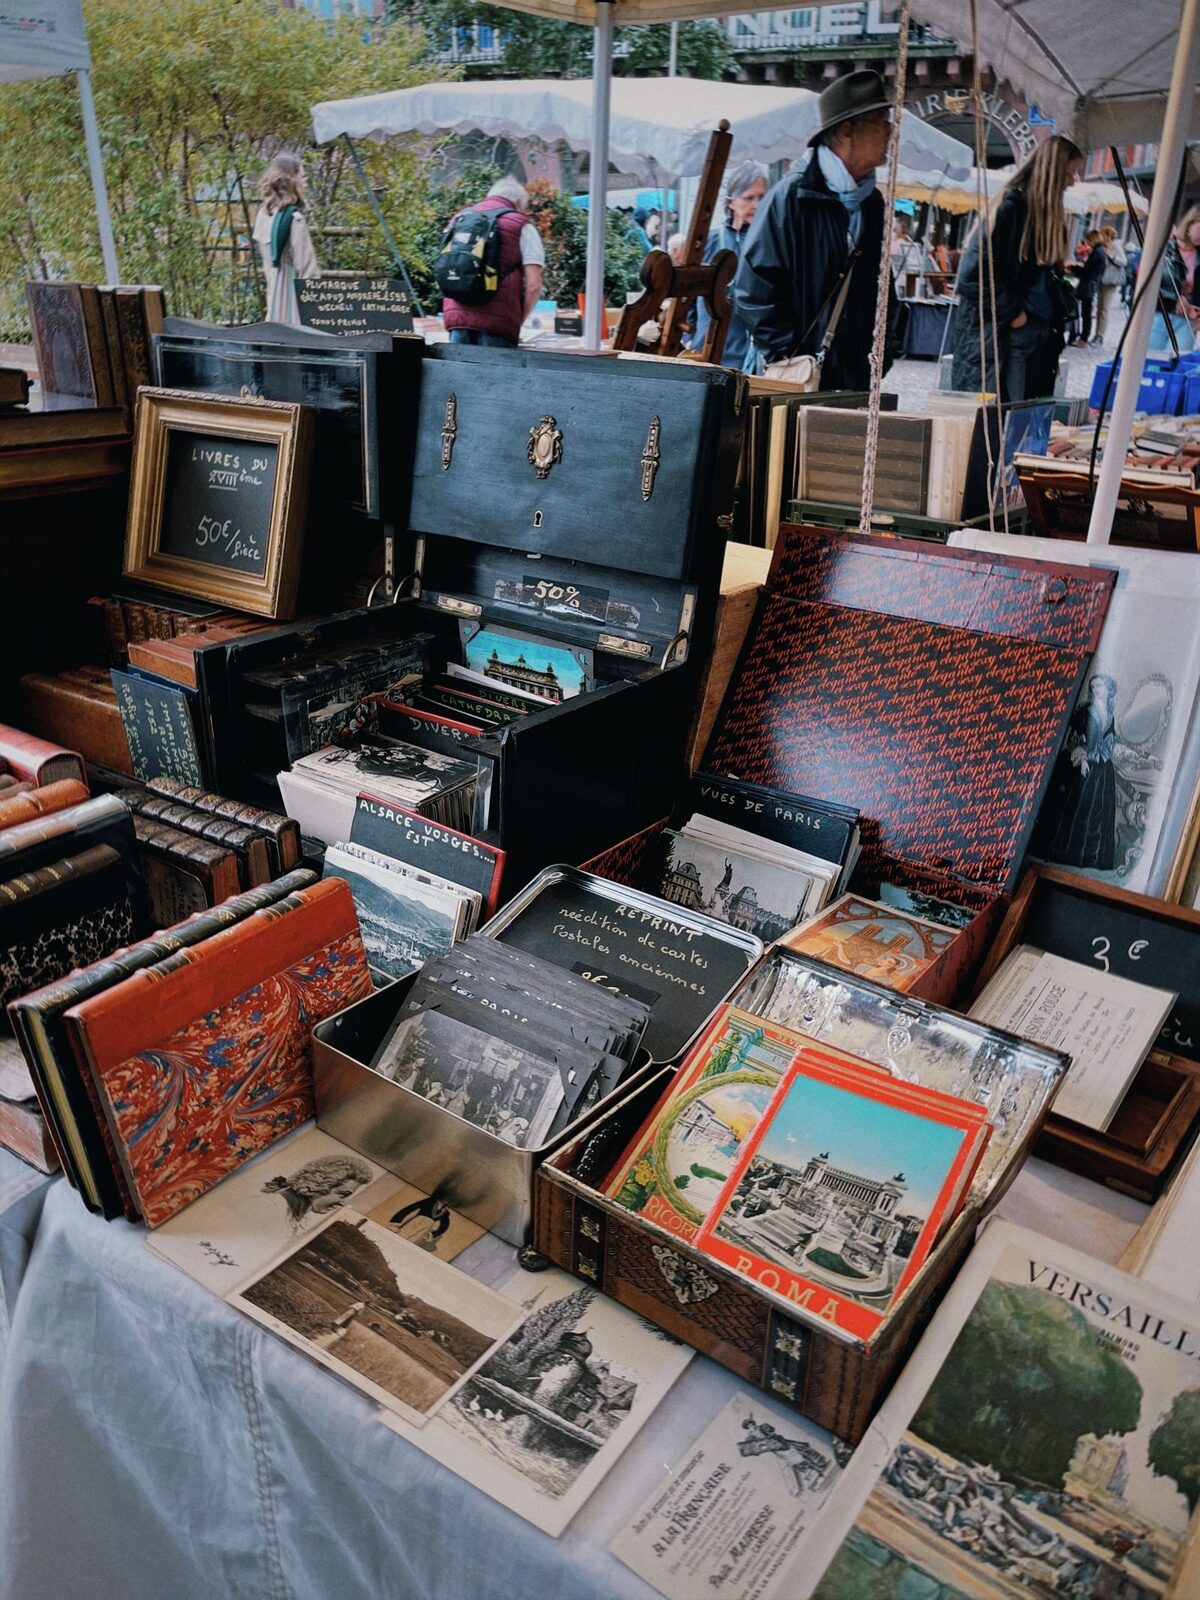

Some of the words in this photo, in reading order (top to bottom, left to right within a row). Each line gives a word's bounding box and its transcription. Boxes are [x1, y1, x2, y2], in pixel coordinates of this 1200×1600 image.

[192, 448, 241, 469] LIVRES
[251, 458, 268, 471] DU
[525, 580, 580, 607] -50%
[360, 800, 413, 827] ALSACE
[701, 786, 736, 805] VUES
[744, 801, 764, 813] DE
[775, 808, 821, 830] PARIS
[406, 830, 435, 847] EST
[615, 904, 704, 942] REPRINT
[638, 933, 656, 949] de
[661, 949, 709, 969] cartes
[619, 954, 706, 995] anciennes
[735, 1255, 840, 1326] ROMA
[1029, 1260, 1200, 1361] VERSAILL
